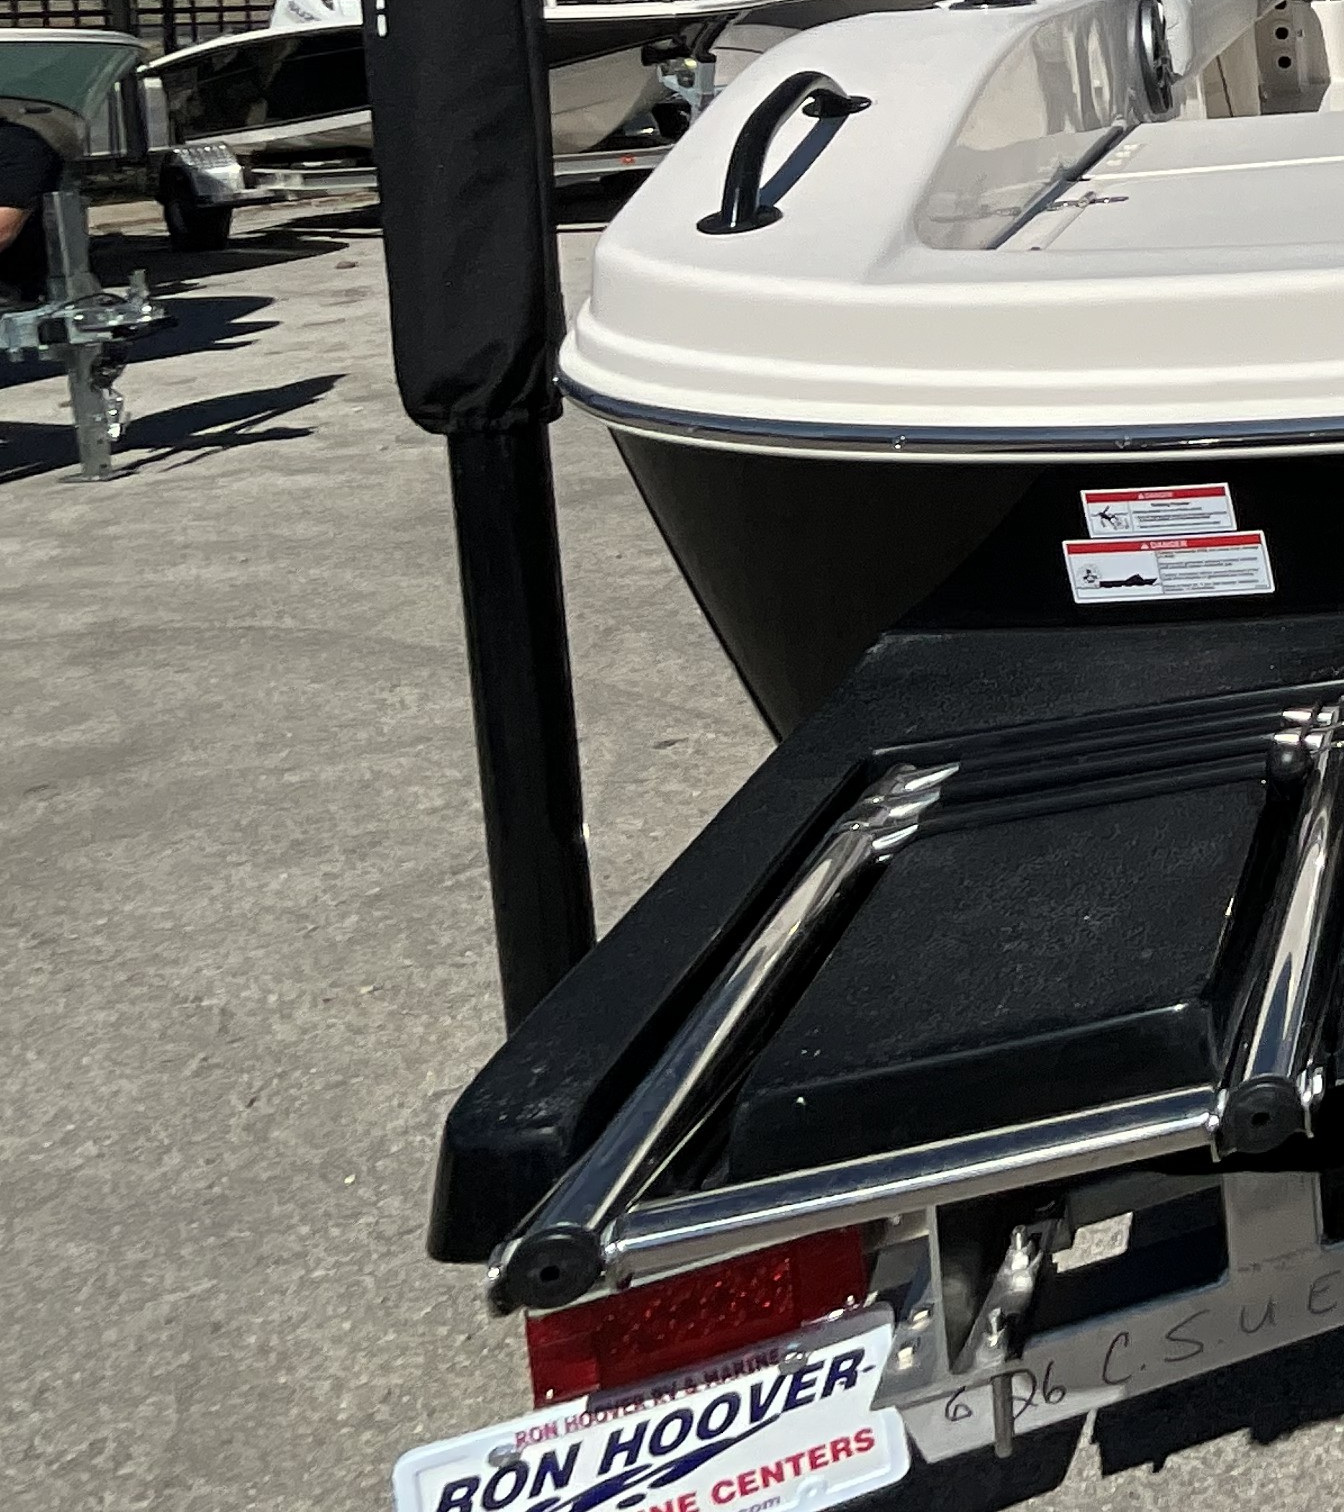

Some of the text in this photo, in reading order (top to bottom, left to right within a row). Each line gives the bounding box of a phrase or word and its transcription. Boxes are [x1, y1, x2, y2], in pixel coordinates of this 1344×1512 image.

[436, 1347, 866, 1512] RON HOOVER
[514, 1421, 558, 1450] RON
[710, 1427, 876, 1505] CENTERS
